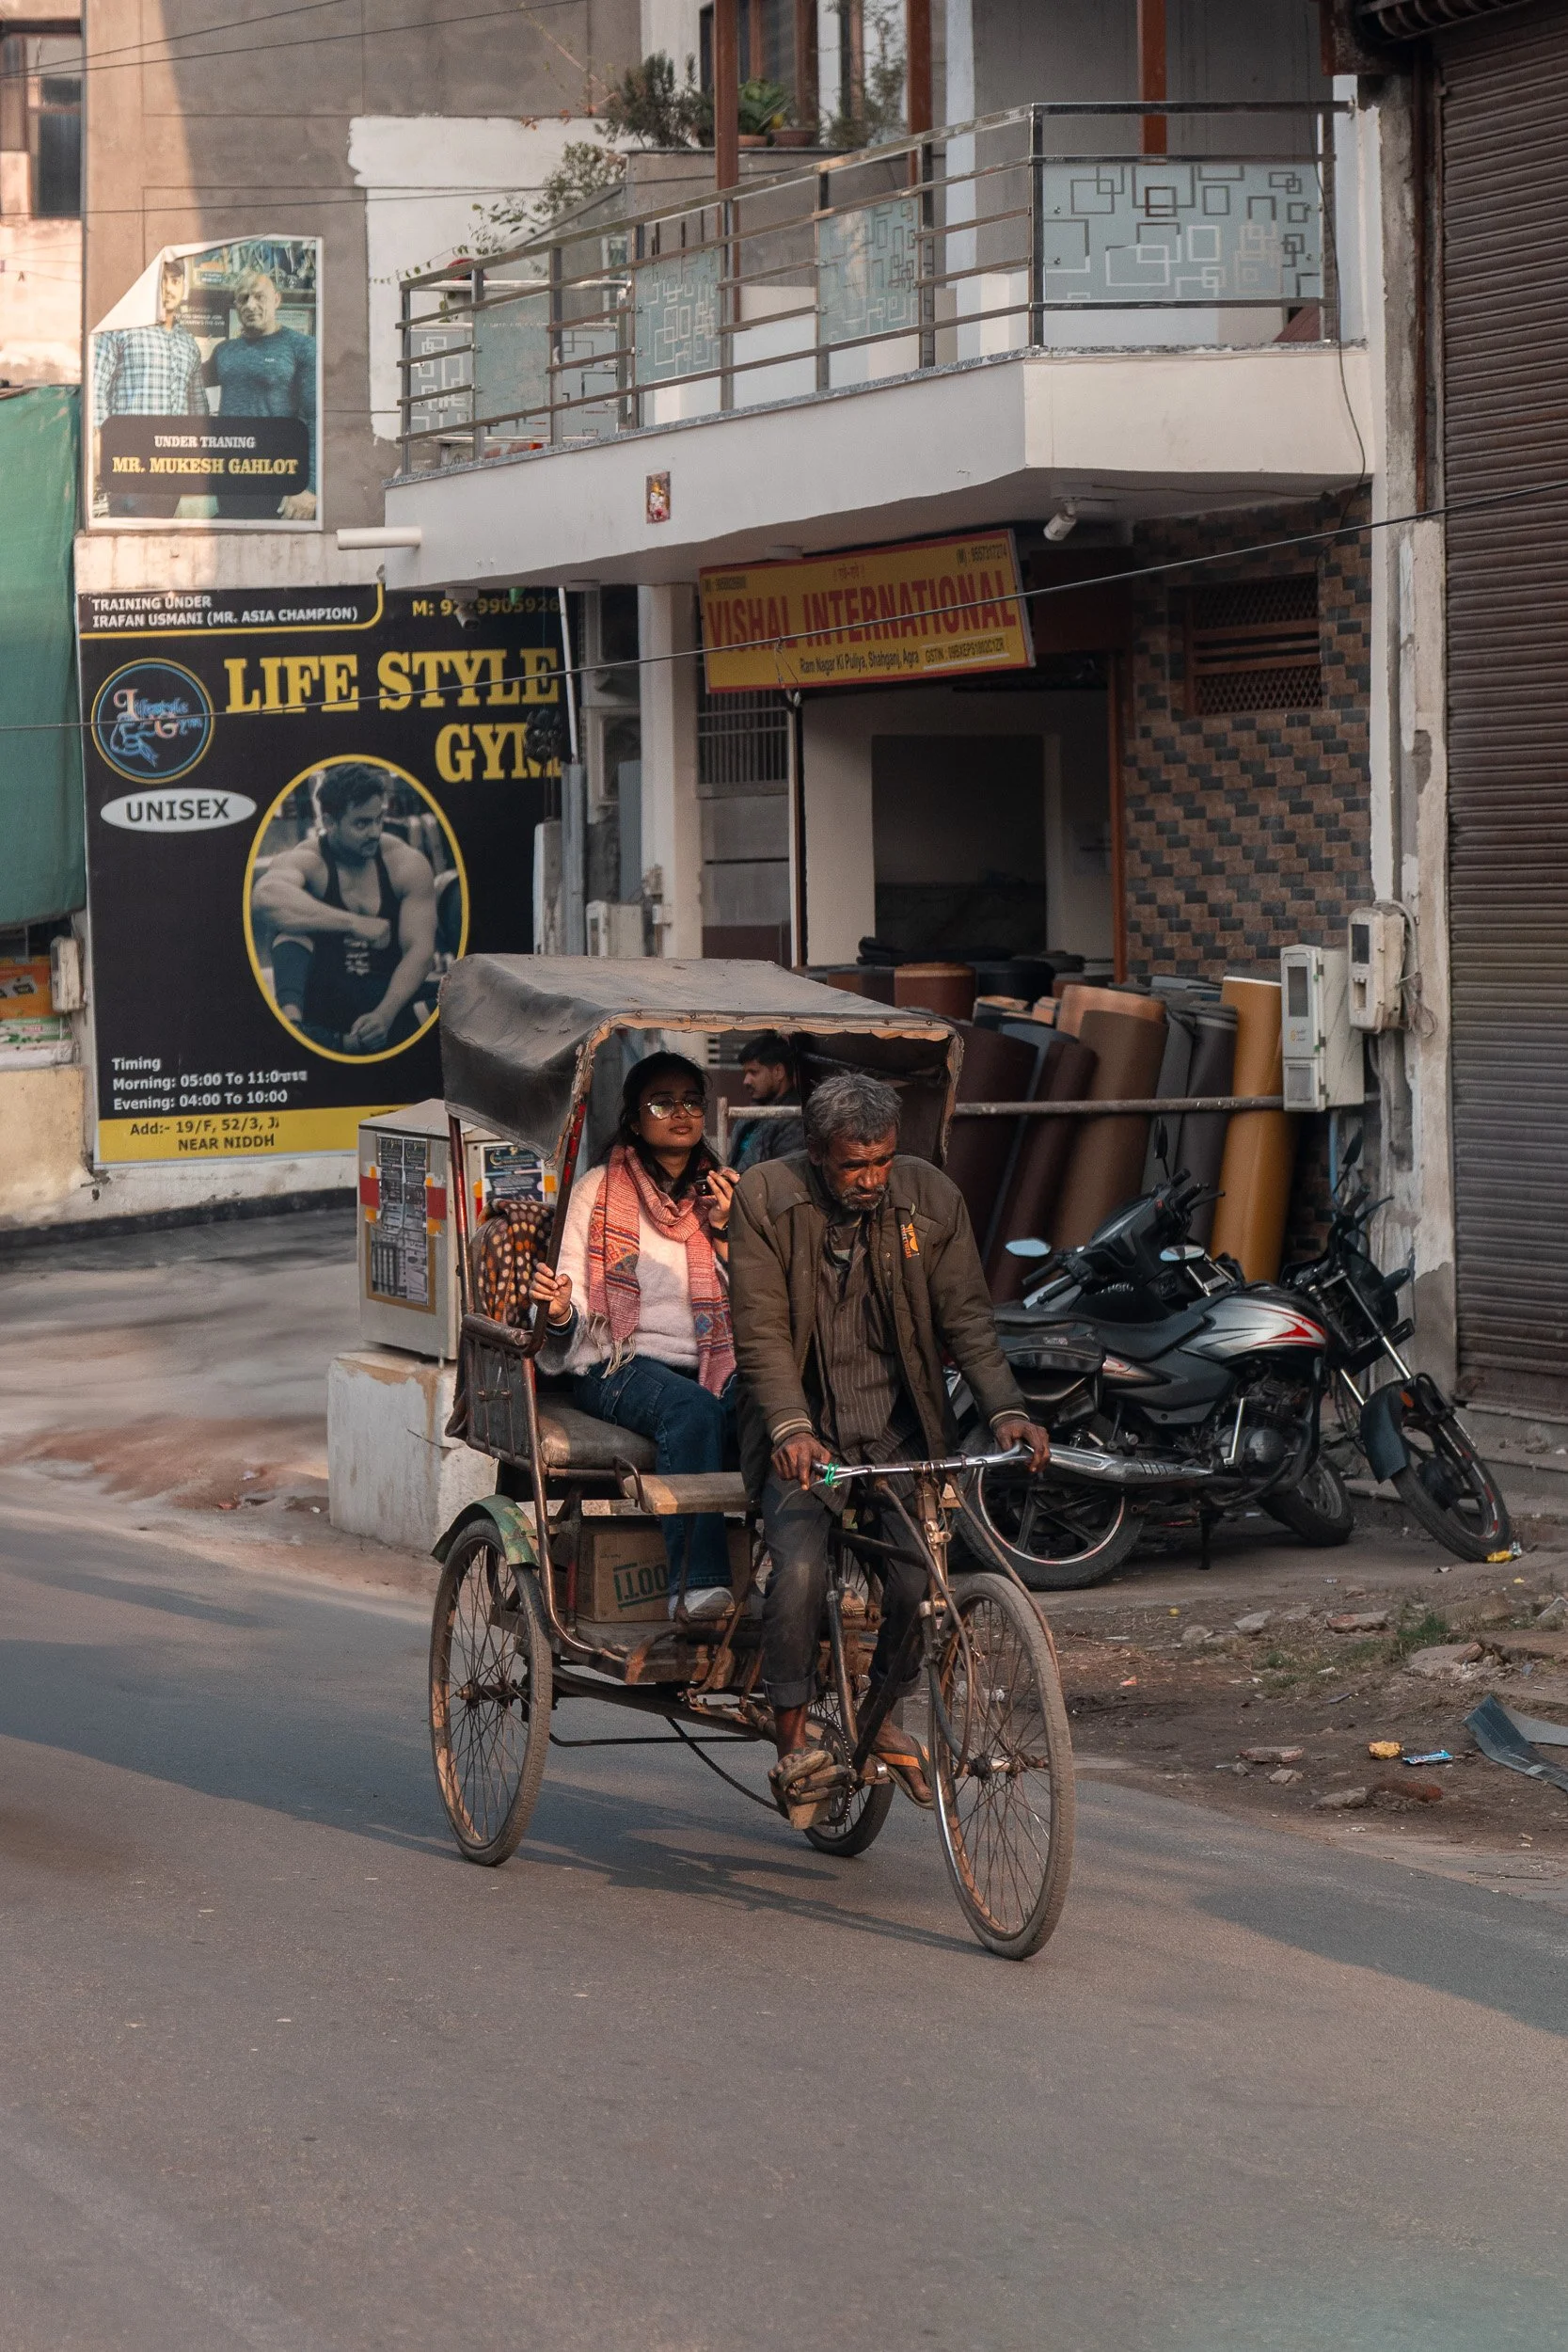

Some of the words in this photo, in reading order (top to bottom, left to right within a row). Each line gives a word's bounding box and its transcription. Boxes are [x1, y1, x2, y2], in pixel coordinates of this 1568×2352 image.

[154, 436, 198, 449] UNDER
[200, 436, 256, 449] TRANING
[112, 457, 145, 473] MR.
[150, 457, 226, 474] MUKESH
[229, 458, 299, 475] GAHLOT
[92, 597, 161, 611] TRAINING
[165, 596, 212, 610] UNDER
[412, 599, 435, 616] M:
[707, 595, 799, 654] VISHAL
[802, 570, 1017, 648] INTERNATIONAL
[92, 614, 144, 628] IRAFAN
[149, 612, 203, 627] USMANI
[207, 611, 238, 627] (MR.
[241, 608, 276, 622] ASIA
[278, 606, 357, 622] CHAMPION)
[816, 656, 835, 676] Nagar
[902, 647, 919, 667] Agra
[224, 655, 359, 714] LIFE
[377, 647, 560, 710] STYLE
[126, 798, 230, 822] UNISEX
[111, 1057, 162, 1073] Timing
[113, 1075, 176, 1092] Morning:
[180, 1073, 222, 1089] 05:00
[225, 1072, 244, 1086] To
[114, 1096, 175, 1112] Evening:
[179, 1092, 221, 1108] 04:00
[225, 1092, 244, 1105] To
[246, 1089, 288, 1104] 10:00
[130, 1121, 170, 1136] Add:-
[175, 1119, 216, 1135] 19/F,
[221, 1117, 263, 1132] 52/3,
[178, 1136, 219, 1152] NEAR
[224, 1133, 275, 1149] NIDDH
